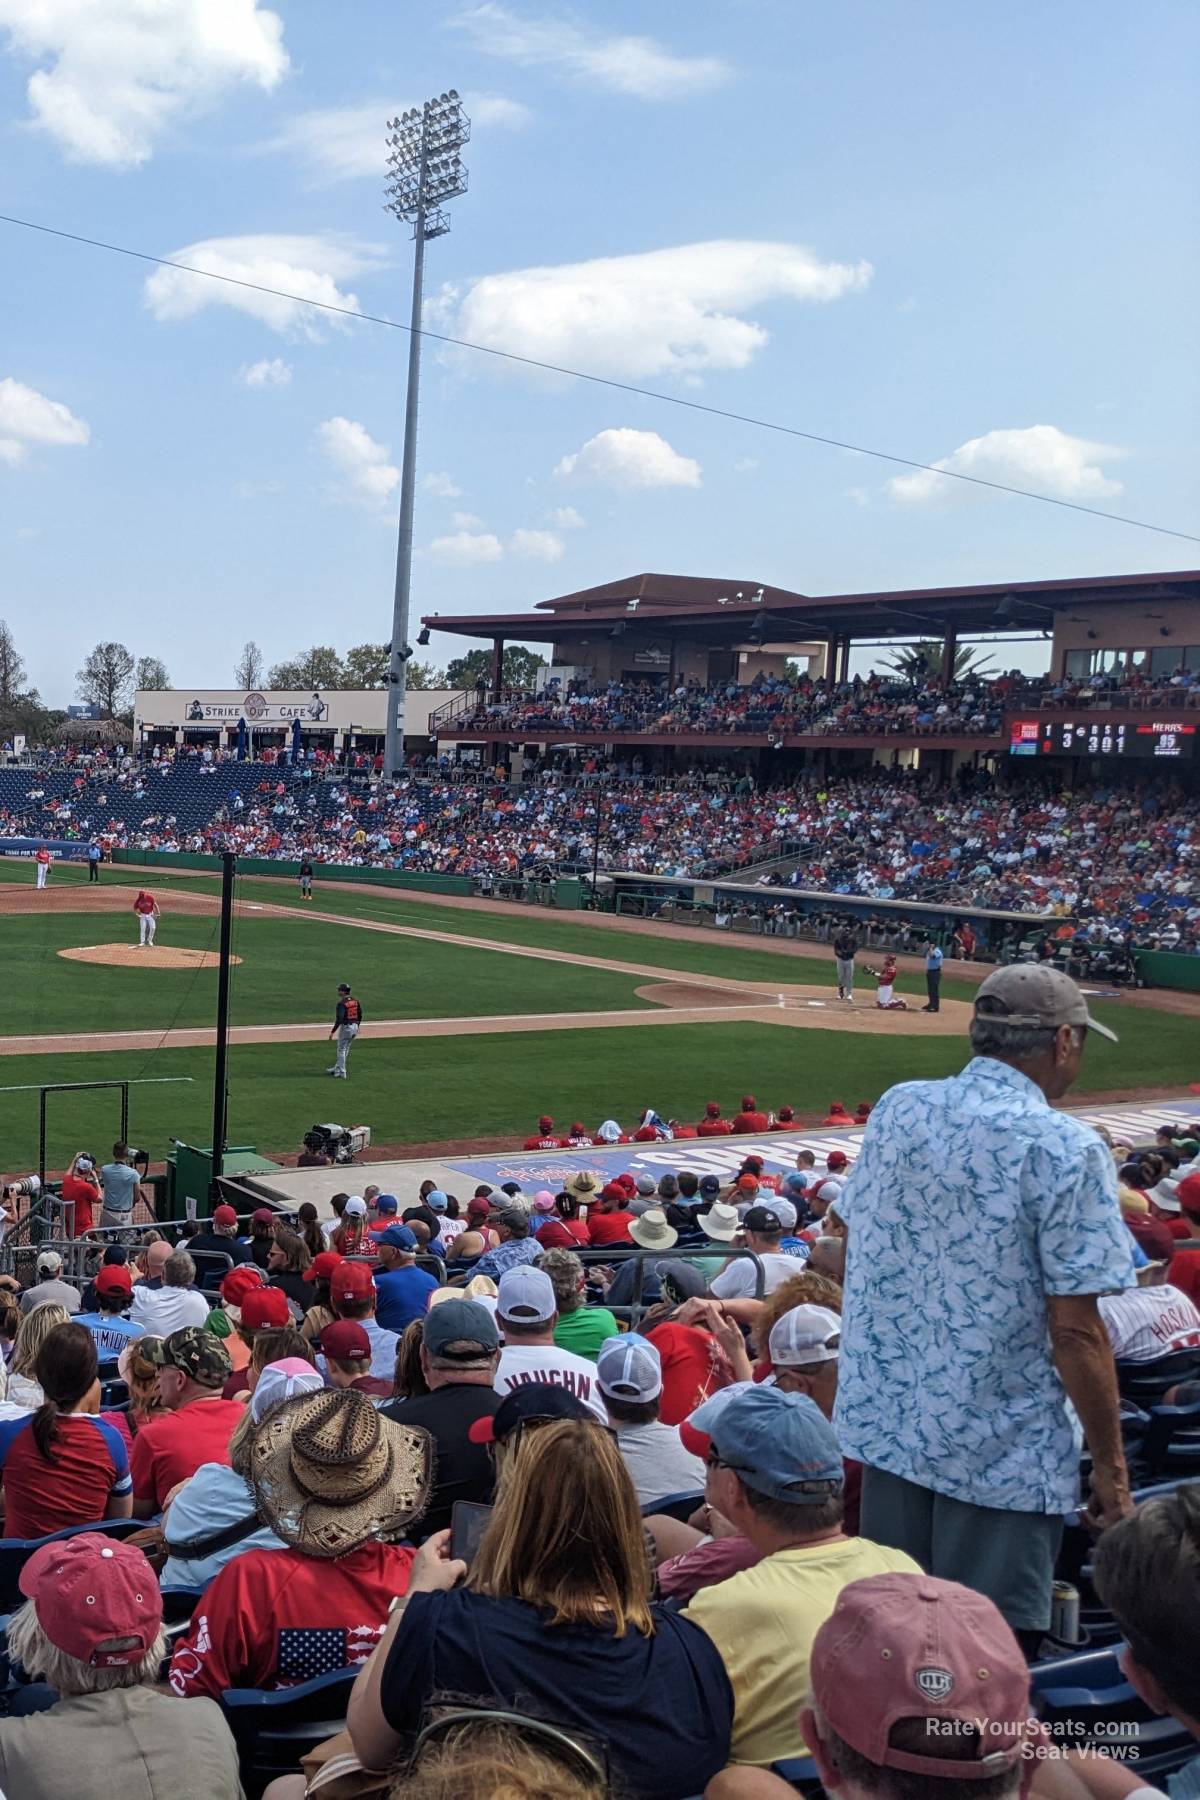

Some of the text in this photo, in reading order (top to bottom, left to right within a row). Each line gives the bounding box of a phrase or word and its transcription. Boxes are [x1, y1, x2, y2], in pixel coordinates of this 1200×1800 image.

[205, 706, 306, 717] STRIKE OUT CAFE
[1045, 724, 1052, 737] 1
[1104, 725, 1112, 734] S
[1062, 733, 1072, 748] 3
[1088, 736, 1099, 752] 3
[1116, 736, 1125, 752] 1
[92, 1329, 131, 1350] HMIDT
[503, 1369, 591, 1401] VAUGHN
